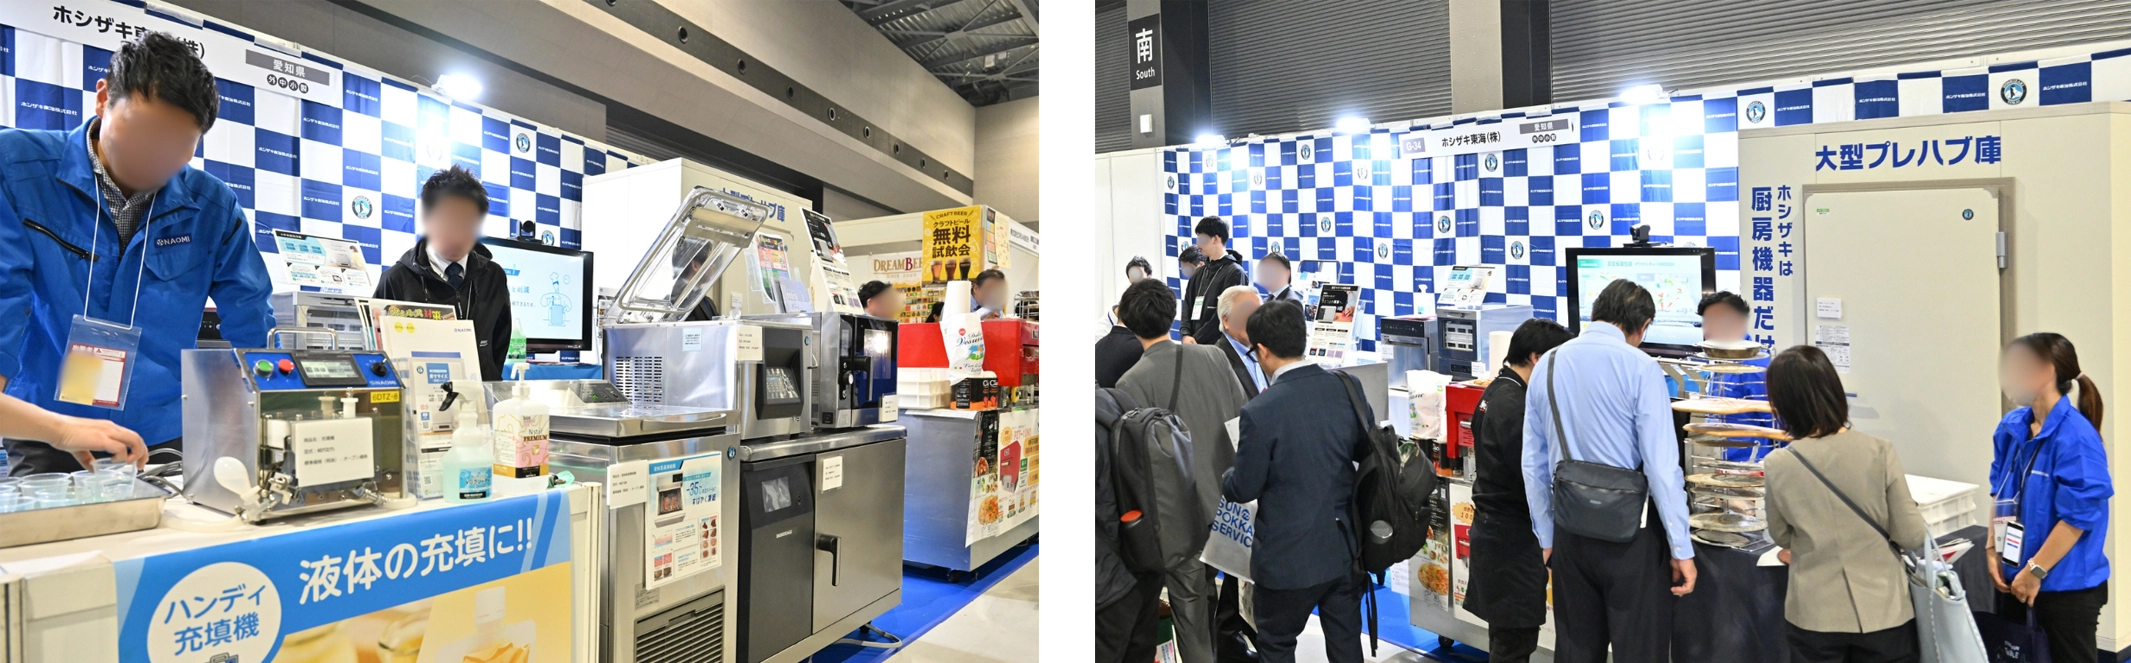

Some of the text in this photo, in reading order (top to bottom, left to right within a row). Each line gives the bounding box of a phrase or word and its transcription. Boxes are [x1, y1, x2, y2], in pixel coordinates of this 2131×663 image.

[1135, 27, 1153, 63] 南
[273, 59, 306, 78] 愛知県
[1136, 67, 1156, 80] South
[1405, 140, 1422, 151] G-34
[1441, 131, 1501, 148] ホシザキ東海(株)
[1815, 135, 2002, 172] 大型プレハブ庫
[933, 218, 971, 228] クラフトビール
[936, 211, 953, 219] CRAFT
[933, 225, 971, 246] 無料
[1777, 185, 1793, 276] ホシザキは
[163, 236, 190, 246] NAOMI
[932, 244, 971, 259] 試飲会
[372, 393, 399, 402] 6DTZ-8
[523, 434, 548, 442] PREMIUM
[1219, 497, 1242, 516] SUN
[1211, 519, 1253, 548] SERVIC
[298, 517, 533, 605] 液体の充填に!!
[163, 583, 267, 624] ハンディ
[173, 611, 260, 657] 充填機
